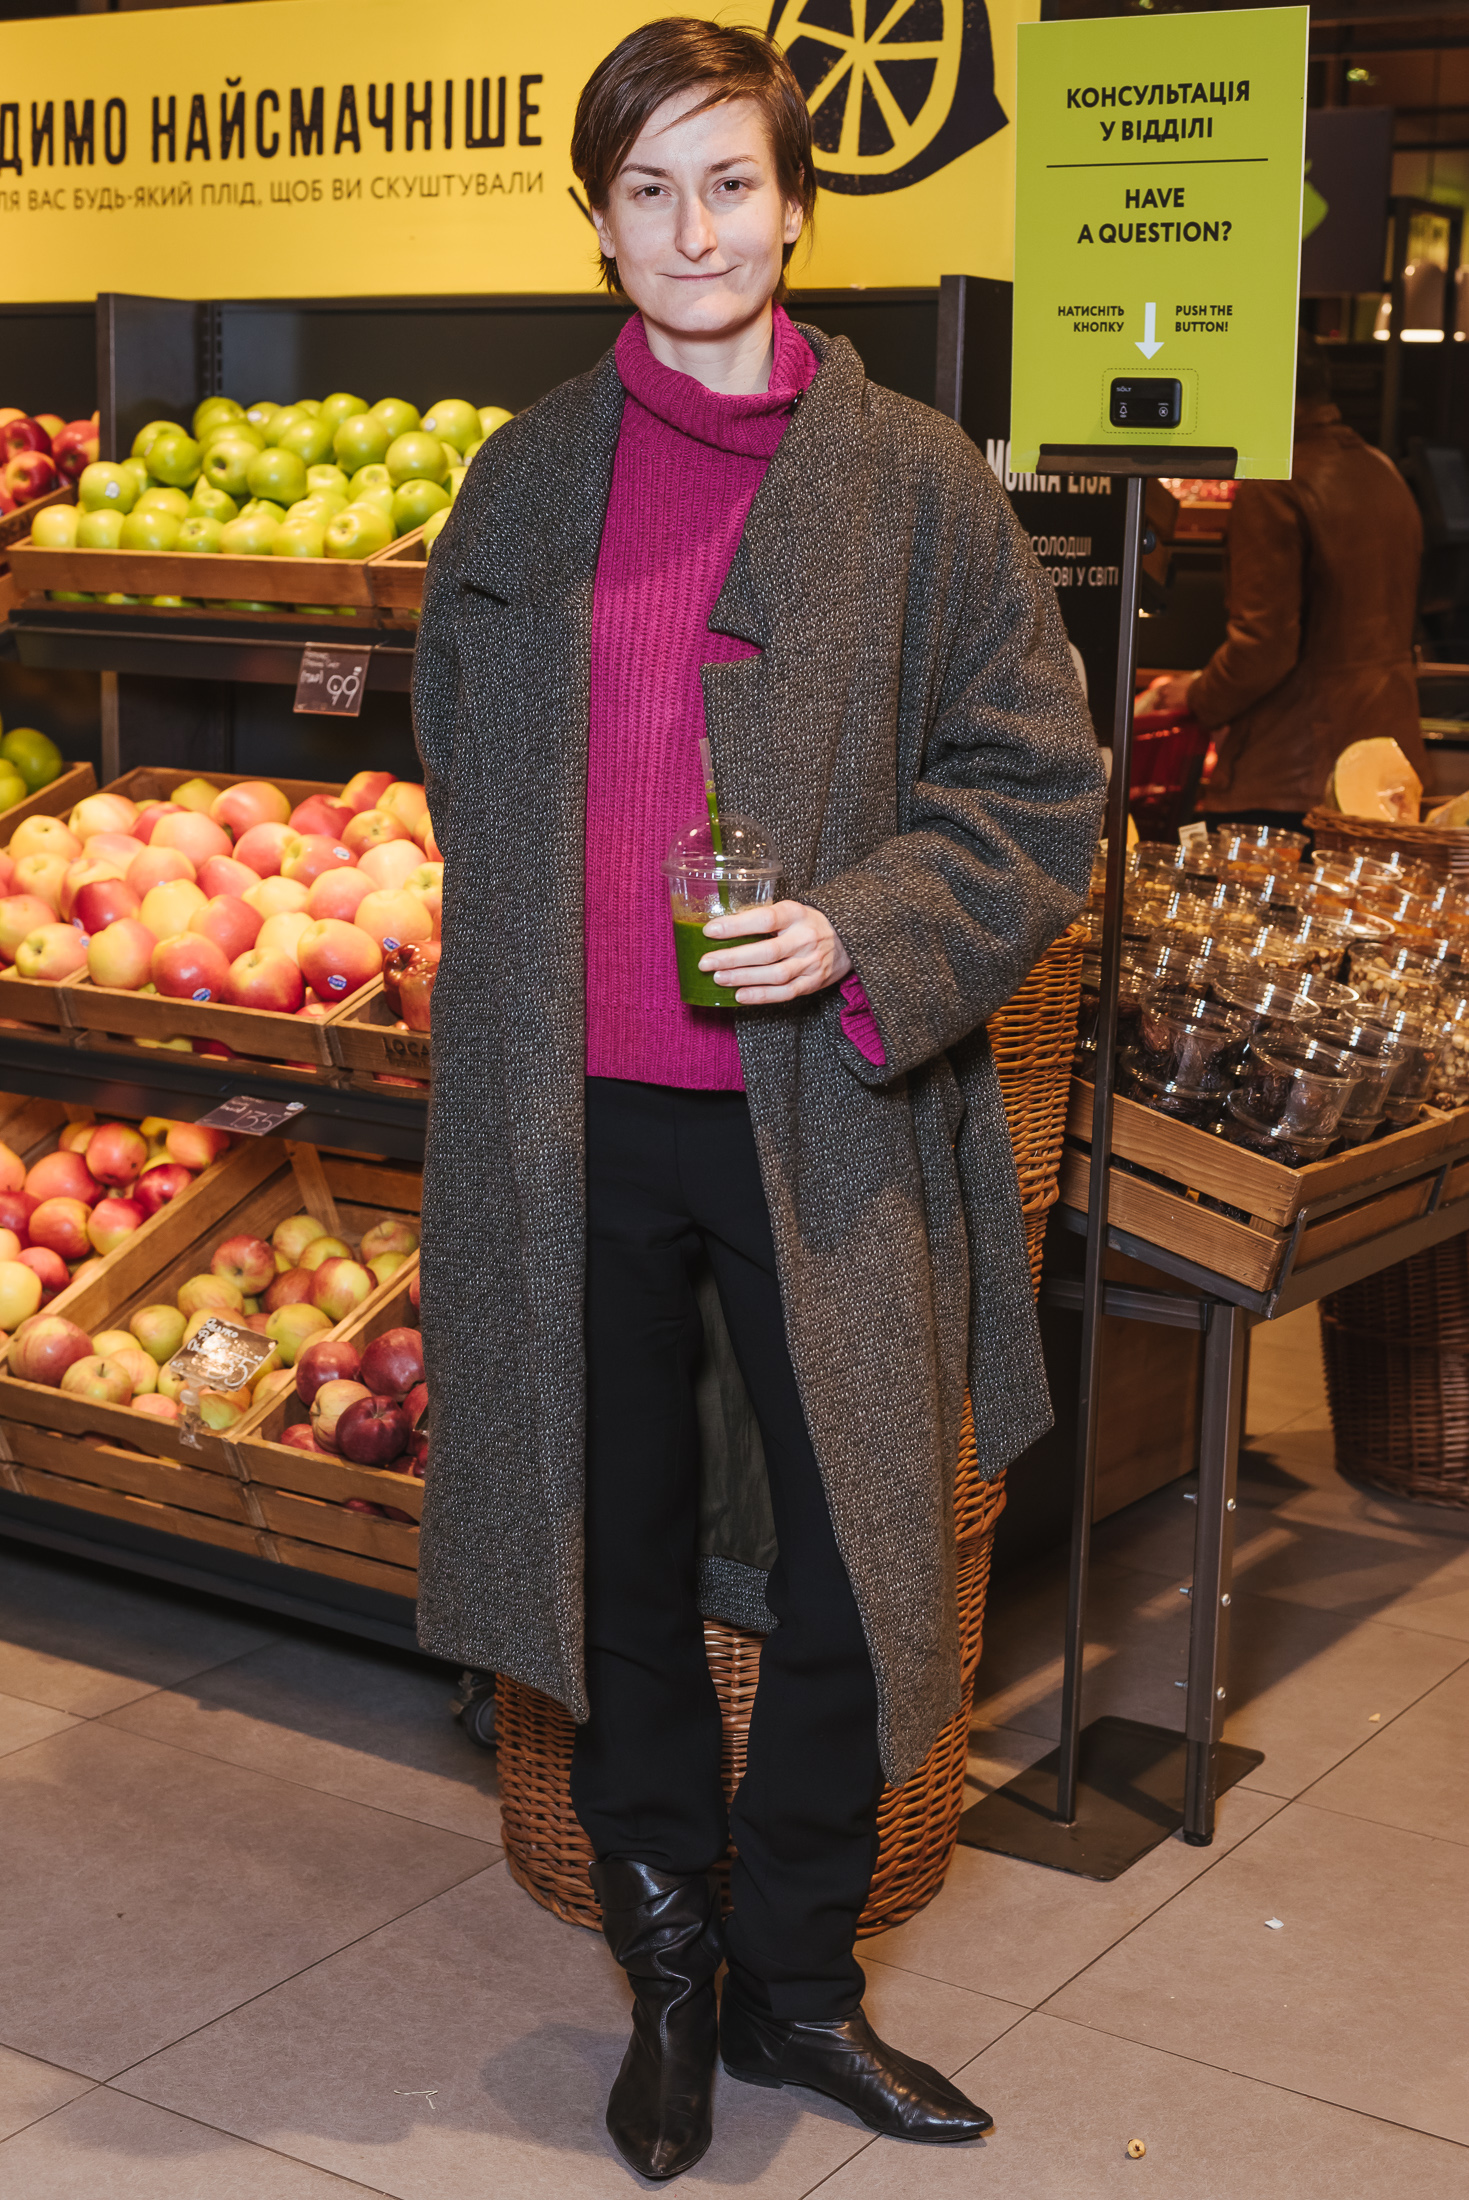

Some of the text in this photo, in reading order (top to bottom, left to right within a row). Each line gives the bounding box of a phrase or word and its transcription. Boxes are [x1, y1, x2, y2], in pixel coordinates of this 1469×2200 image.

[1067, 80, 1250, 109] КОНСУЛЬТАЦІЯ
[152, 74, 544, 164] НАЙСМАЧНІШЕ
[1100, 117, 1213, 144] У ВІДДІЛІ
[28, 188, 67, 212] ВАС
[73, 180, 193, 213] БУДЬ-ЯКИЙ
[201, 181, 262, 207] ПЛІД,
[270, 178, 323, 205] ЩОБ
[332, 177, 362, 202] ВИ
[370, 171, 544, 200] СКУШТУВАЛИ
[1125, 187, 1185, 209] HAVE
[1077, 220, 1232, 244] A QUESTION?
[1058, 305, 1125, 317] НАТИСНІТЬ
[1175, 305, 1233, 316] PUSH THE
[1073, 321, 1125, 333] КНОПКУ
[1175, 321, 1229, 333] BUTTON!
[1028, 535, 1092, 559] СОЛОДШІ
[1076, 566, 1086, 587] У
